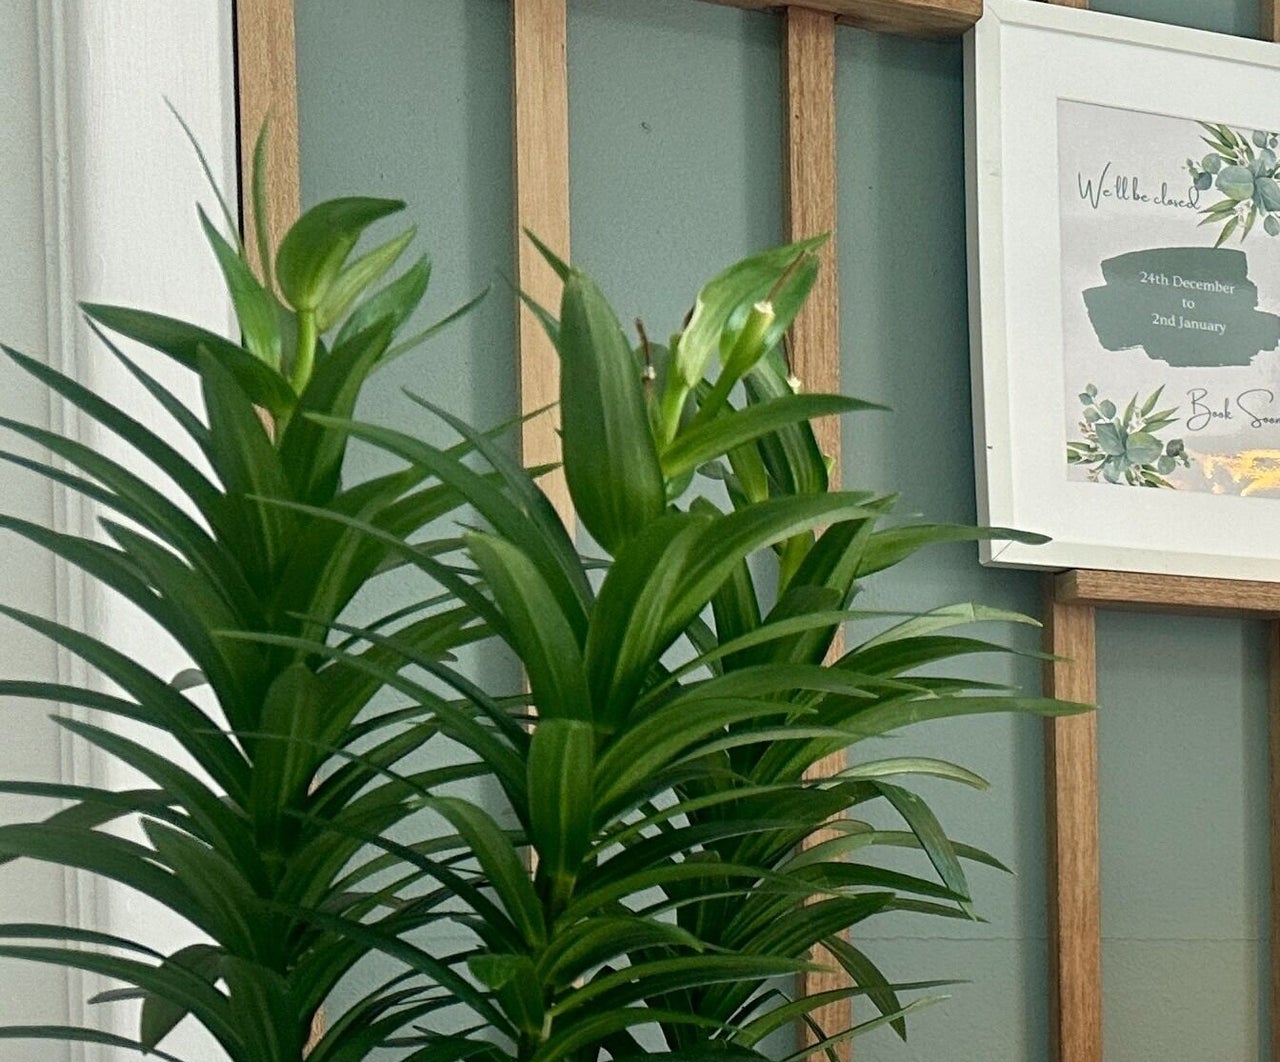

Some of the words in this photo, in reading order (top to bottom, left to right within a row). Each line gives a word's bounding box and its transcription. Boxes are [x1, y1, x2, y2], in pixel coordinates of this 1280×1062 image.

[1132, 176, 1150, 203] be
[1153, 182, 1200, 210] closed
[1139, 271, 1169, 286] 24th
[1173, 275, 1235, 294] December
[1182, 298, 1195, 309] to
[1151, 313, 1176, 327] 2nd
[1178, 316, 1227, 336] January
[1186, 388, 1233, 431] Book
